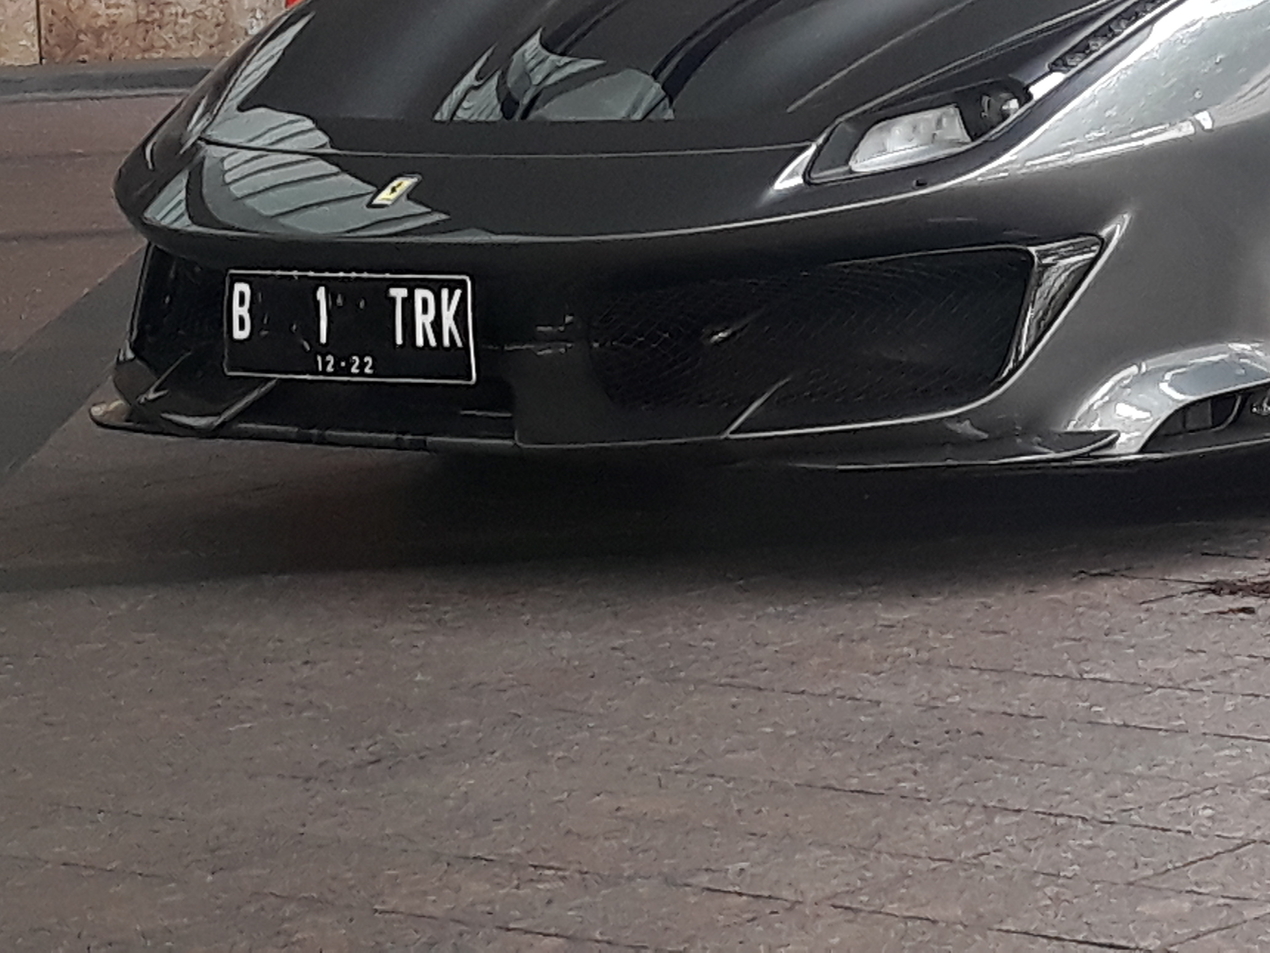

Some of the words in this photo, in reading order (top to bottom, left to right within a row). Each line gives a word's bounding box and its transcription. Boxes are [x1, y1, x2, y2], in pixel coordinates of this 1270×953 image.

[232, 282, 251, 340] B
[316, 286, 328, 344] 1
[389, 287, 463, 348] TRK
